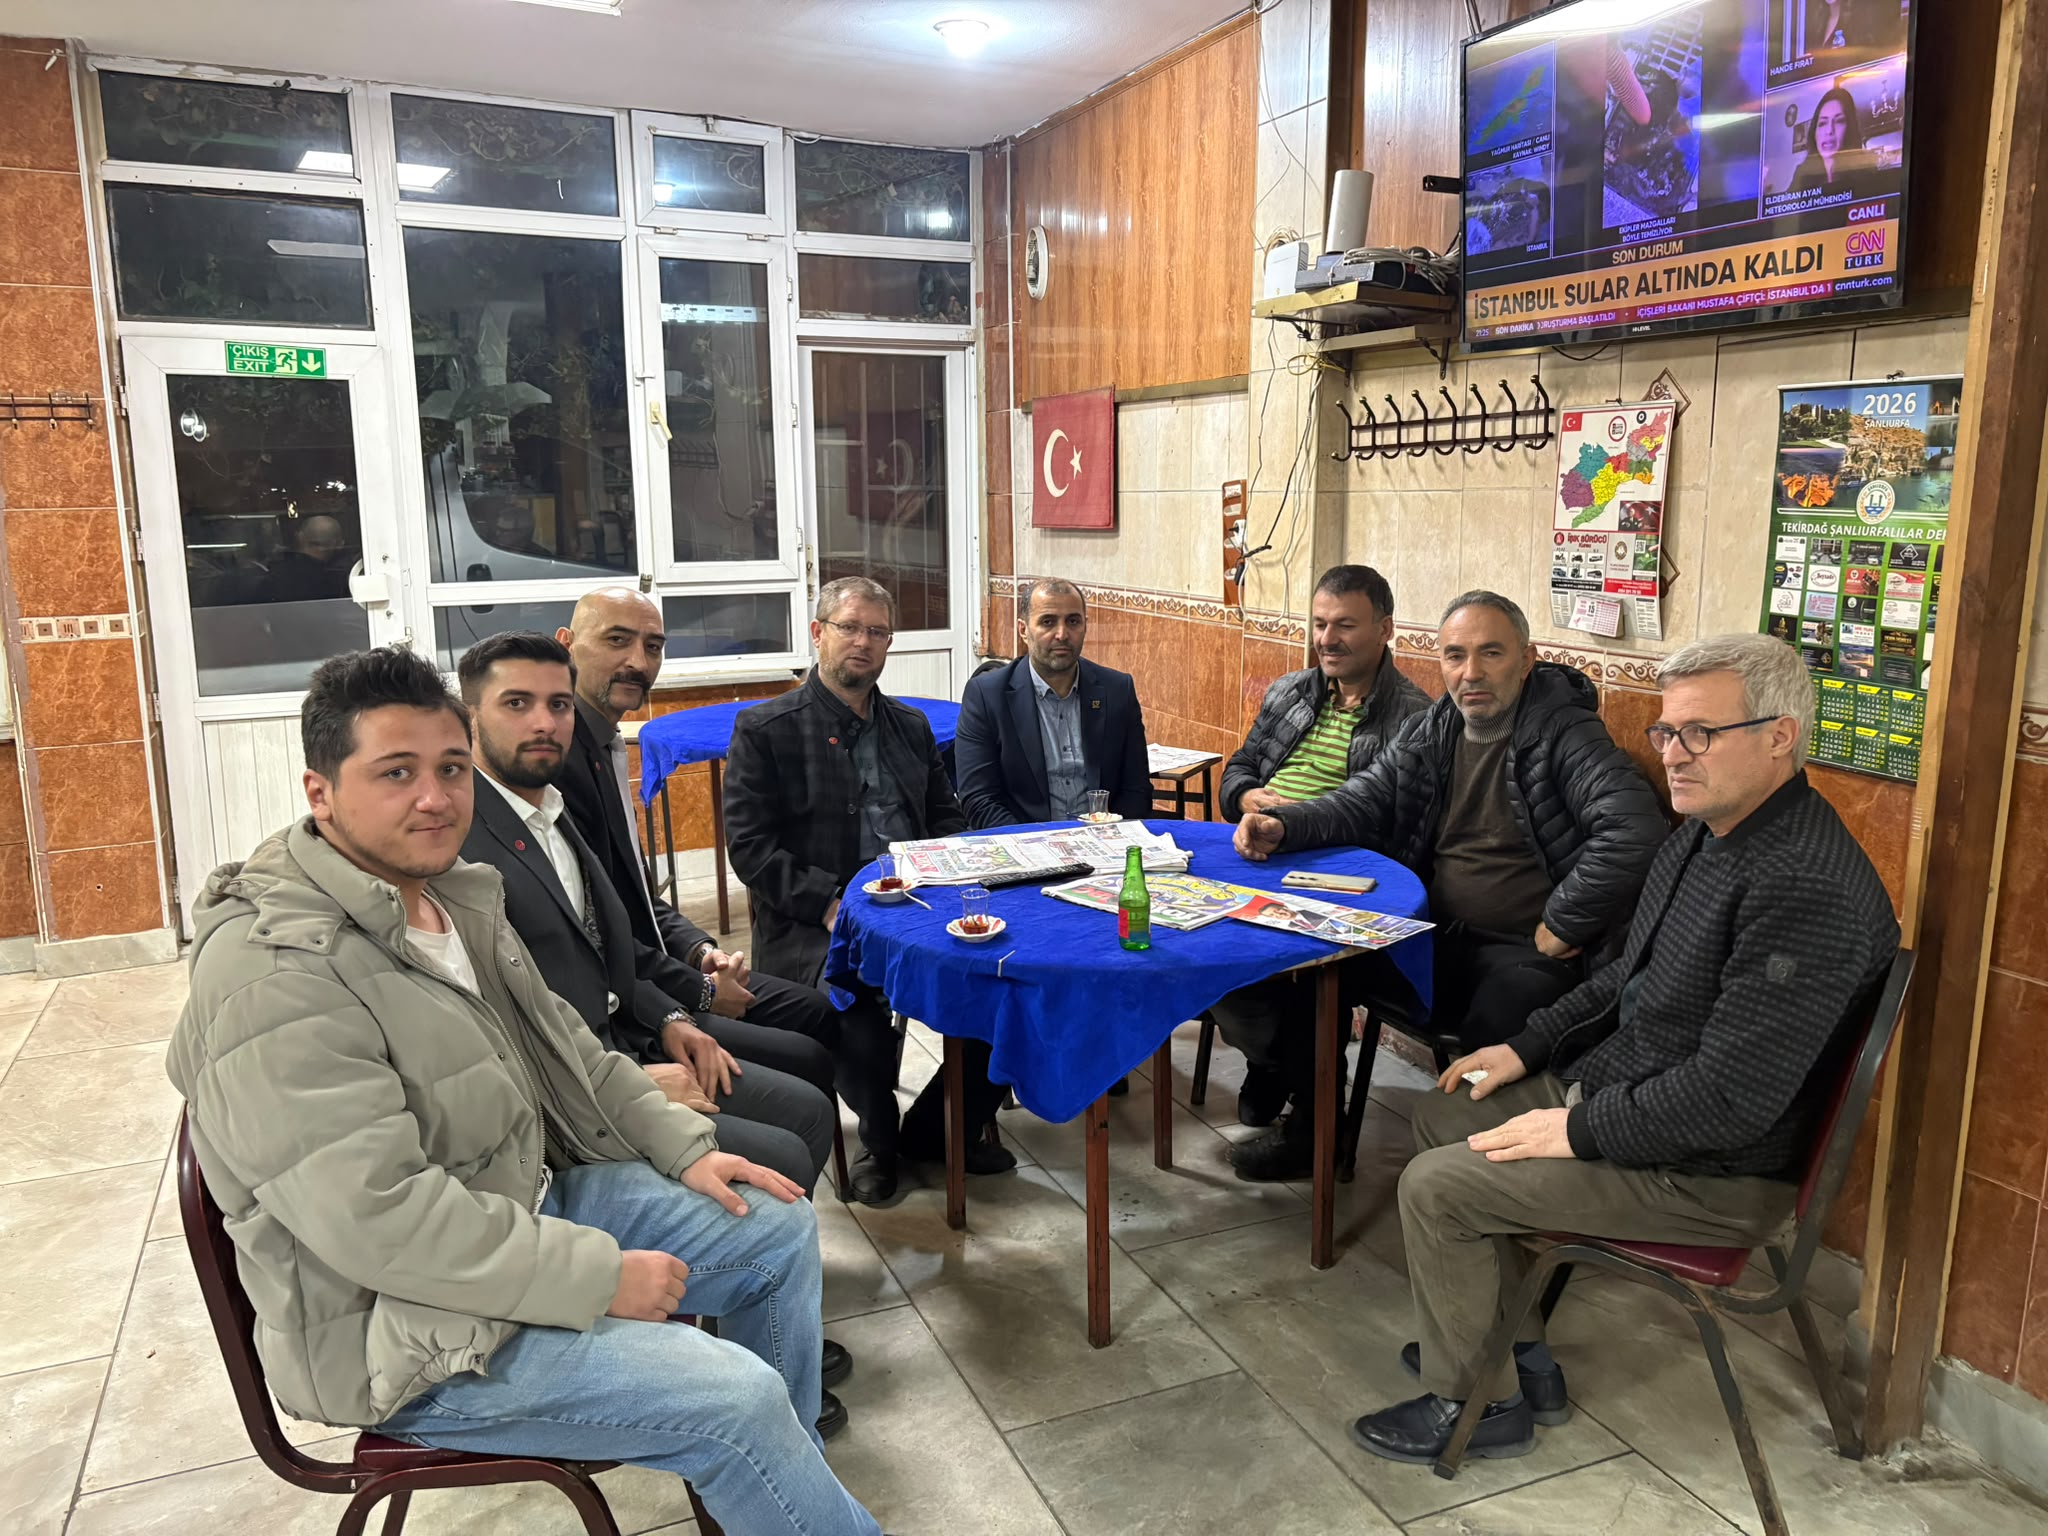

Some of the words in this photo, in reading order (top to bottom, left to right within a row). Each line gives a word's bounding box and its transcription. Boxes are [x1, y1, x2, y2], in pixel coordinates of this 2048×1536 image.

[1770, 63, 1793, 76] HANDE
[1794, 57, 1814, 70] FIRAT
[1802, 187, 1822, 198] AYAN
[1765, 199, 1812, 215] METEOROLOJİ
[1813, 190, 1852, 206] MÜHENDİSİ
[1848, 204, 1885, 221] CANLI
[1622, 232, 1640, 243] BÖYLE
[1846, 227, 1886, 254] CNN
[1526, 242, 1548, 253] İSTANBUL
[1612, 249, 1636, 264] SON
[1640, 240, 1684, 260] DURUM
[1474, 287, 1559, 320] İSTANBUL
[1564, 276, 1630, 307] SULAR
[1635, 258, 1736, 297] ALTINDA
[1744, 243, 1823, 281] KALDI
[1835, 276, 1893, 291] cnnturk.com
[1495, 326, 1509, 335] SON
[1509, 323, 1534, 334] DAKİKA
[1578, 311, 1615, 325] BAŞLATILDI
[1637, 306, 1666, 319] İÇİŞLERİ
[1667, 301, 1696, 314] BAKANI
[1696, 297, 1734, 310] MUSTAFA
[232, 345, 269, 359] ÇIKIŞ
[233, 361, 269, 371] EXIT
[1862, 392, 1917, 415] 2026
[1864, 419, 1911, 430] ŞANLIURFA
[1781, 521, 1828, 534] TEKİRDAĞ
[1829, 524, 1923, 539] ŞANLIURFALILAR
